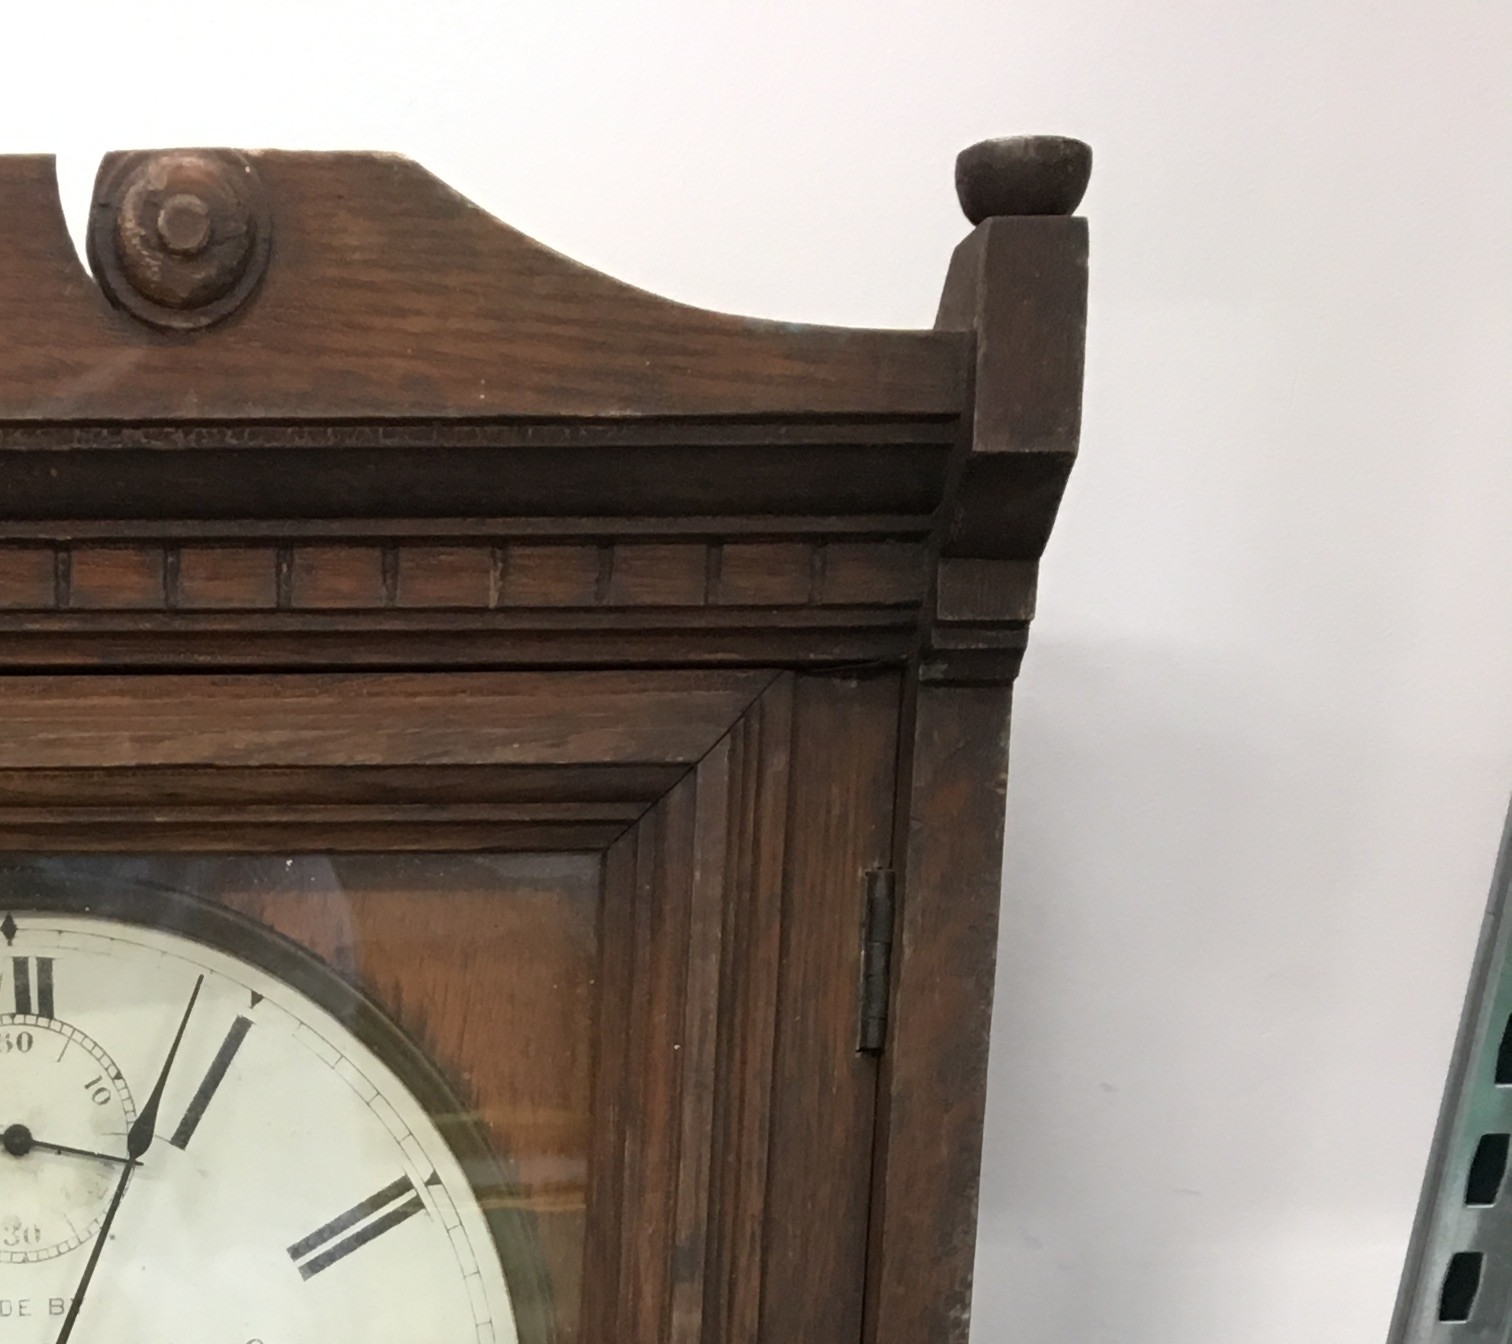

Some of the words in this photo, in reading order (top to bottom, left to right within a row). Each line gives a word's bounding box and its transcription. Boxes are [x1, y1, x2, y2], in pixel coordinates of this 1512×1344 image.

[84, 1075, 112, 1107] 10
[2, 1214, 42, 1247] 30
[48, 1296, 85, 1317] B
